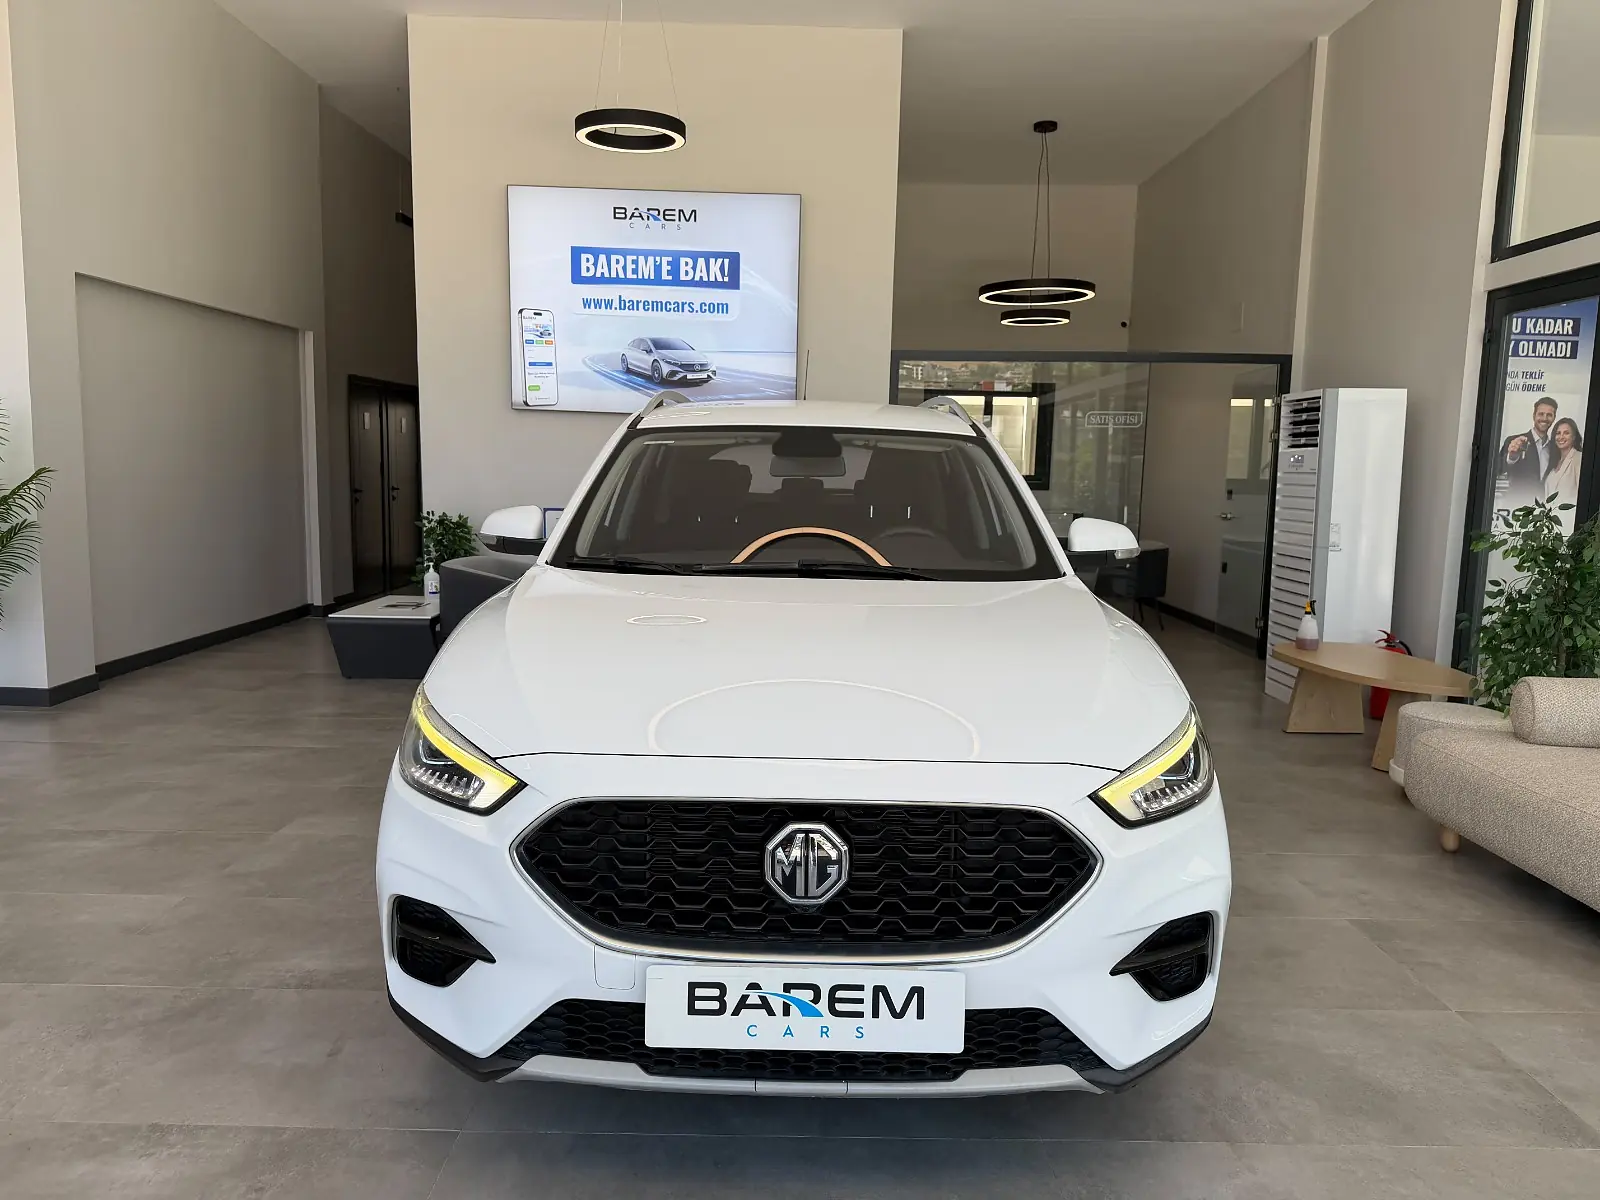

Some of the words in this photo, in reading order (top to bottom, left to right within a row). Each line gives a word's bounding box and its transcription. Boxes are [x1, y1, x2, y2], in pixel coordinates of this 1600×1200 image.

[613, 206, 697, 223] BAREM
[629, 222, 682, 231] CARS
[580, 253, 673, 281] BAREM'E
[679, 257, 730, 282] BAK!
[582, 294, 729, 315] www.baremcars.com
[1526, 318, 1573, 334] KADAR
[1518, 341, 1571, 357] OLMADI
[1521, 369, 1545, 380] TEKLİF
[1521, 381, 1547, 393] ÖDEME
[774, 833, 839, 898] MG
[687, 981, 925, 1020] BAREM
[746, 1024, 865, 1039] CARS
